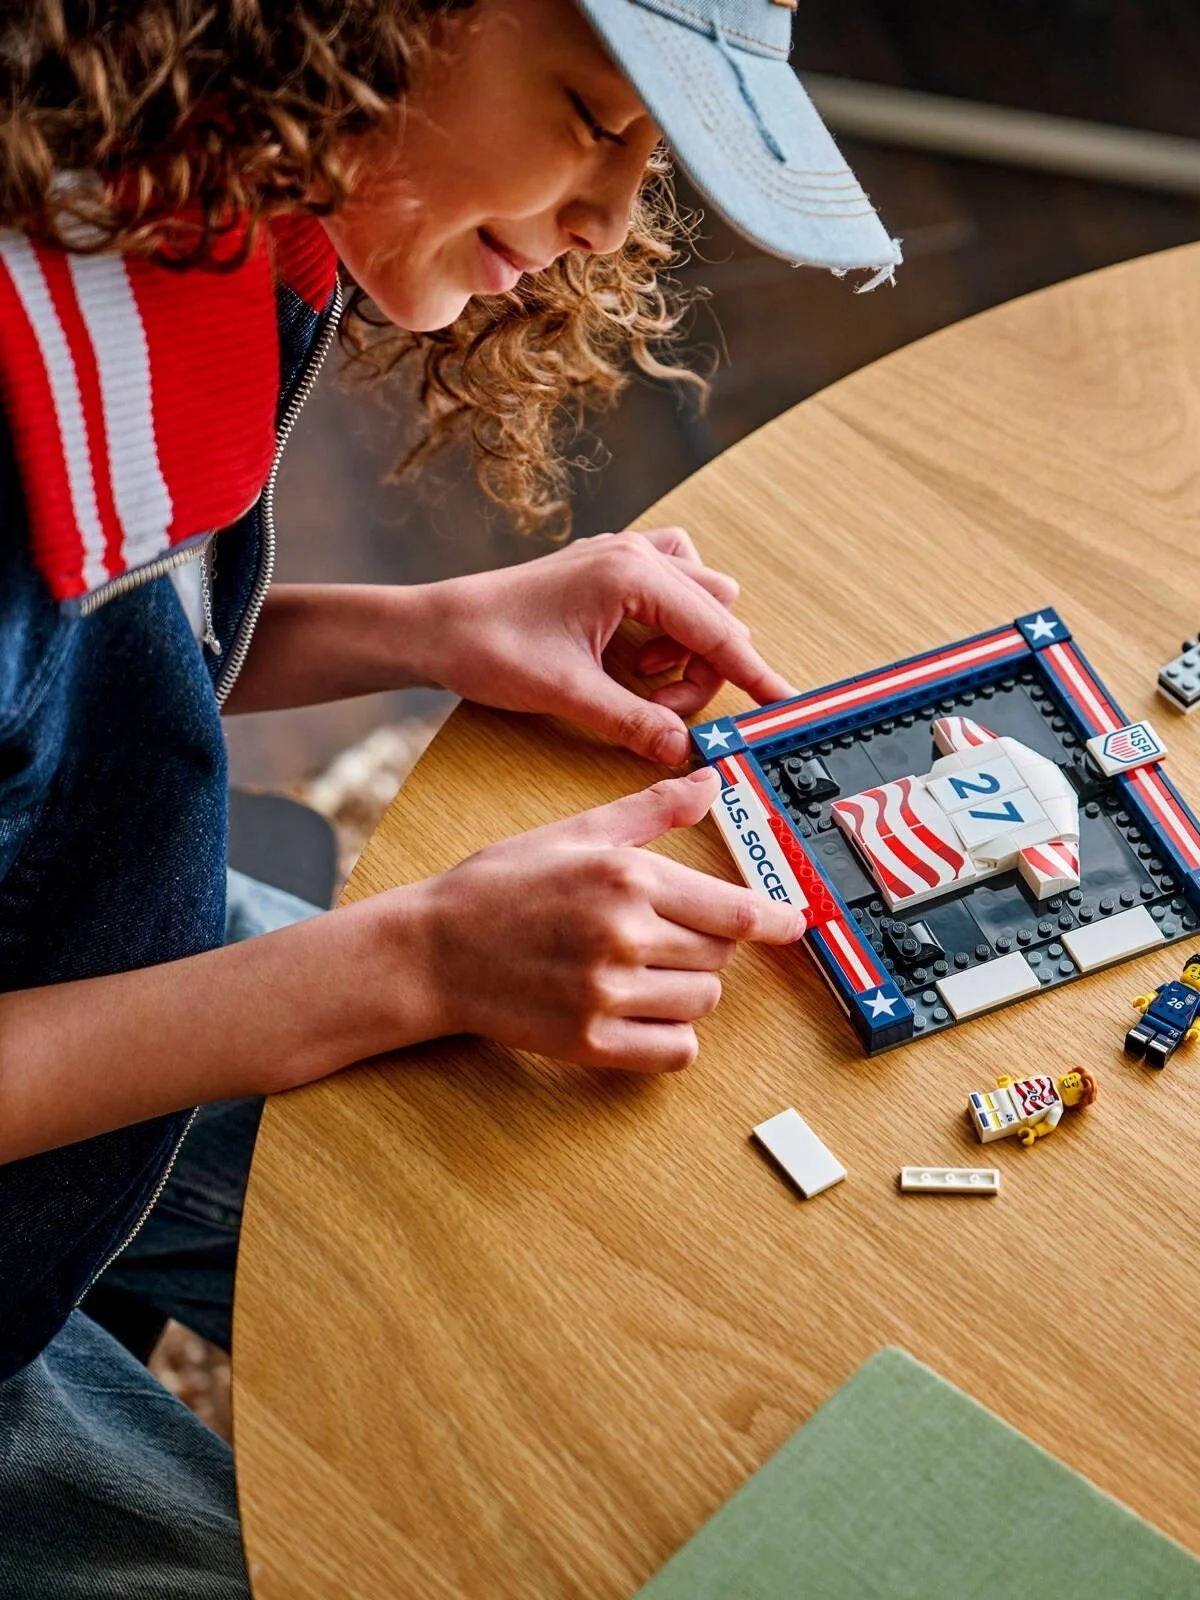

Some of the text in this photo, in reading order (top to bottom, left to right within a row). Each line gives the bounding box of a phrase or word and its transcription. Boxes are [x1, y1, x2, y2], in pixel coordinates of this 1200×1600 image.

[1130, 730, 1152, 752] USA
[948, 772, 1025, 823] 27
[721, 787, 749, 830] U.S.
[1167, 997, 1185, 1010] 26
[1168, 1029, 1179, 1038] 26
[1027, 1089, 1041, 1102] 26
